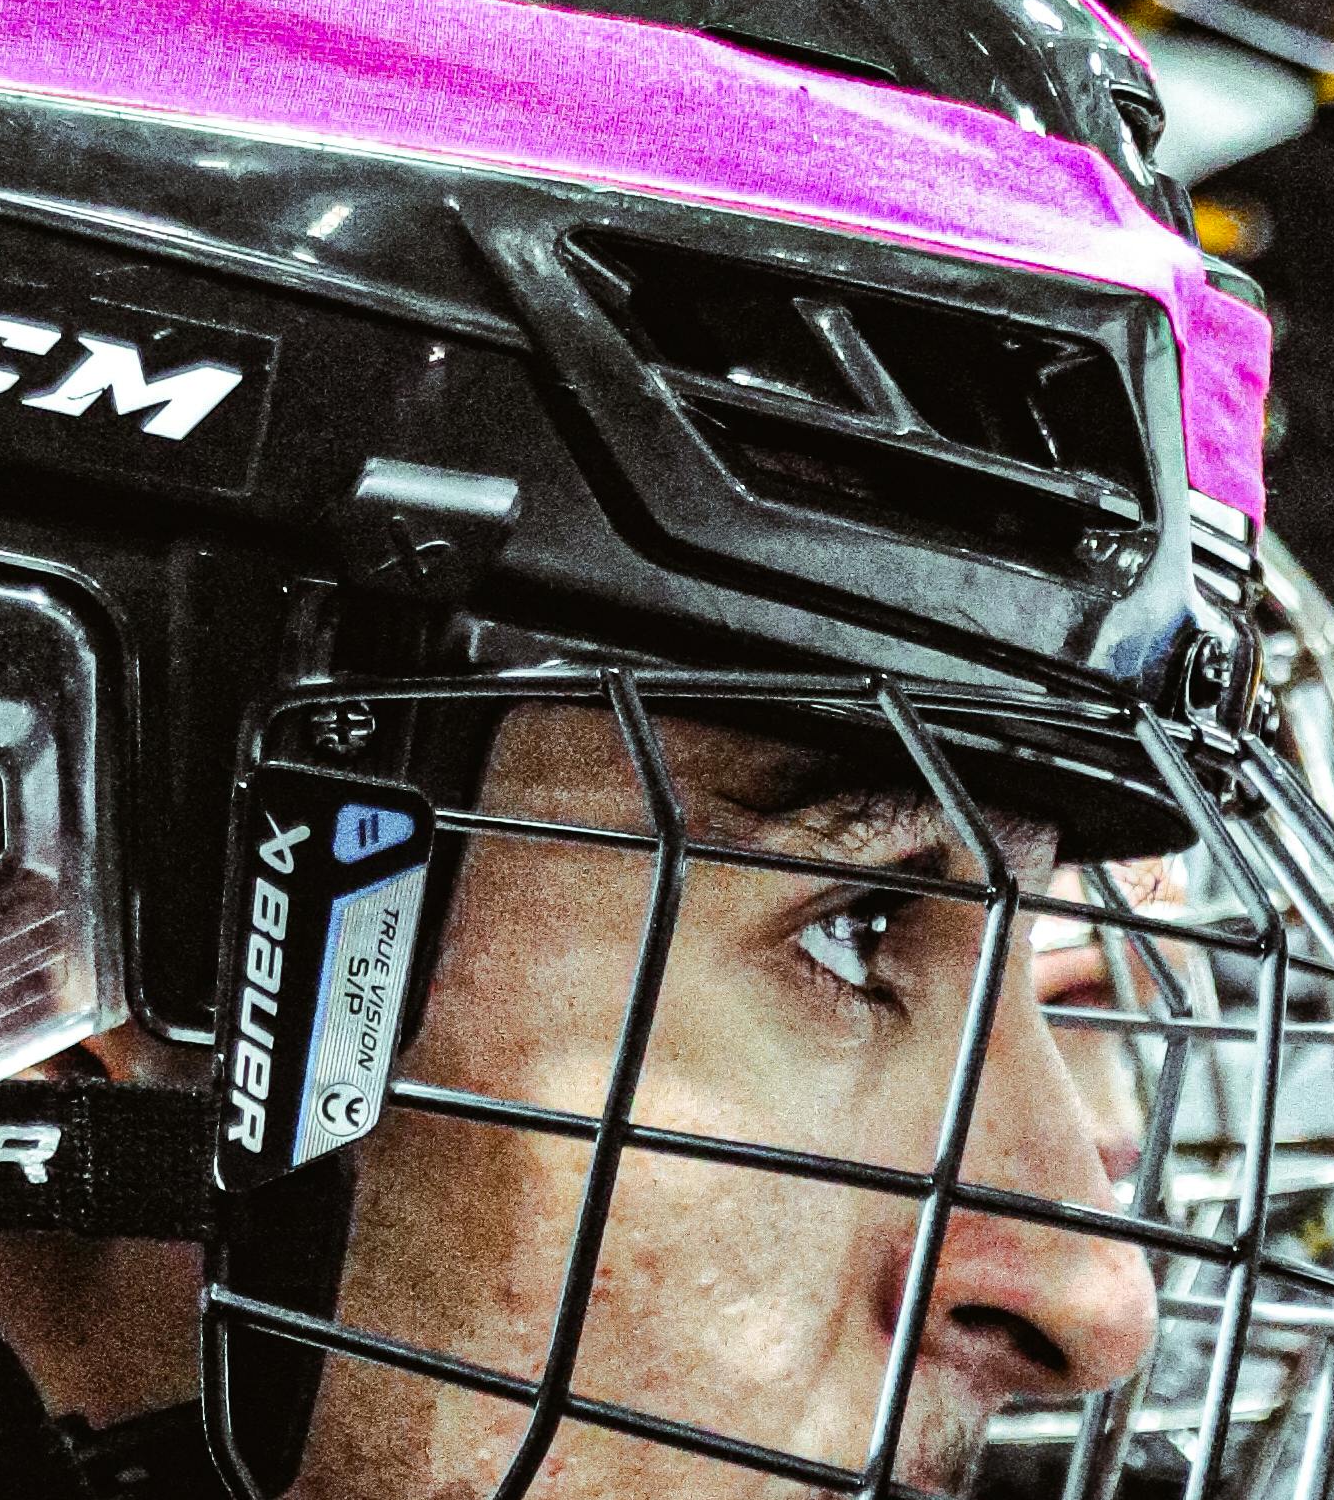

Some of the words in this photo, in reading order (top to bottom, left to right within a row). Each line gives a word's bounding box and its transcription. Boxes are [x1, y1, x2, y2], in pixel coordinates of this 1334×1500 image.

[373, 906, 400, 975] TRUE
[343, 955, 370, 1017] S/P
[357, 984, 386, 1073] VISION
